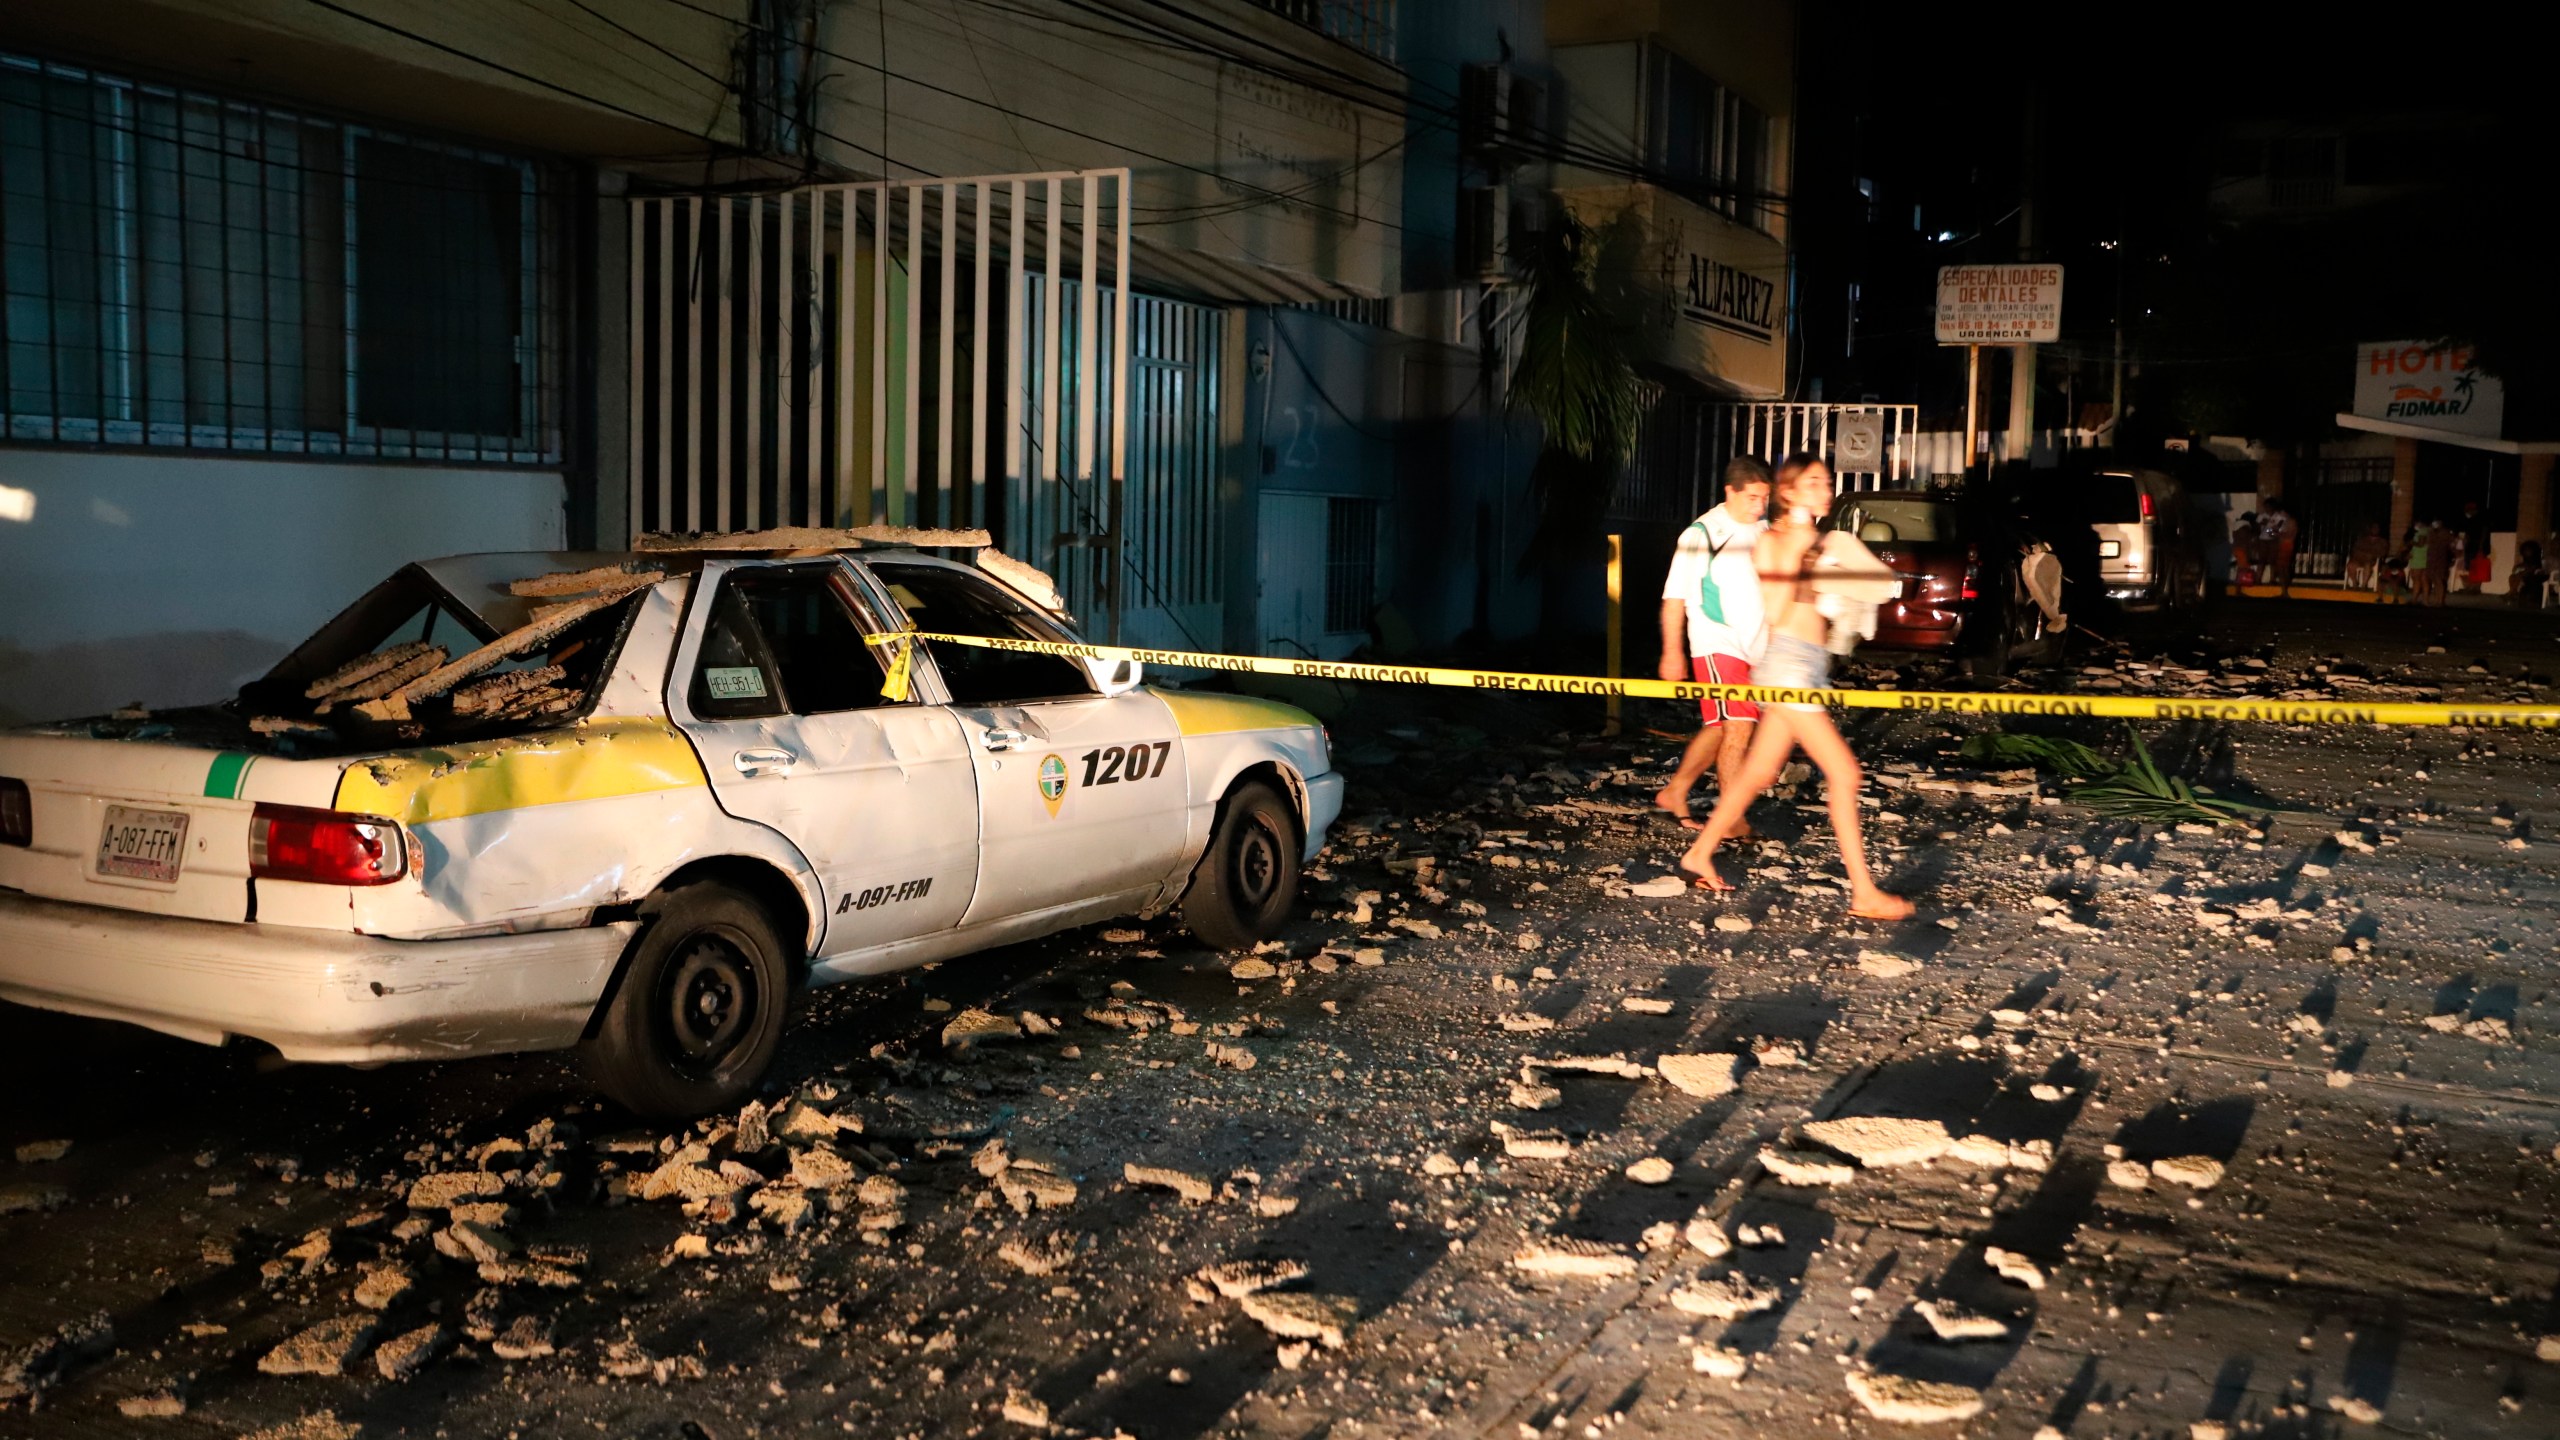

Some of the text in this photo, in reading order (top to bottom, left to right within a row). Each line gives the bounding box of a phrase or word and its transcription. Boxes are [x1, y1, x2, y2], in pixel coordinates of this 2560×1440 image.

[1685, 253, 1774, 330] ALVAREZ
[1943, 269, 2057, 286] ESPECIALIDADES
[1958, 287, 2038, 303] DENTALES
[2370, 347, 2480, 375] HOTE
[2386, 400, 2462, 417] FIDMAR
[1131, 650, 1255, 671] PRECAUCION
[1293, 663, 1430, 684] PRECAUCION
[1473, 675, 1626, 696] PRECAUCION
[1674, 686, 1846, 706] PRECAUCION
[1899, 695, 2094, 716] PRECAUCION
[2154, 703, 2377, 723] PRECAUCION
[1081, 741, 1171, 788] 1207
[102, 824, 178, 861] A-087-FFM
[834, 877, 933, 915] A-097-FFM
